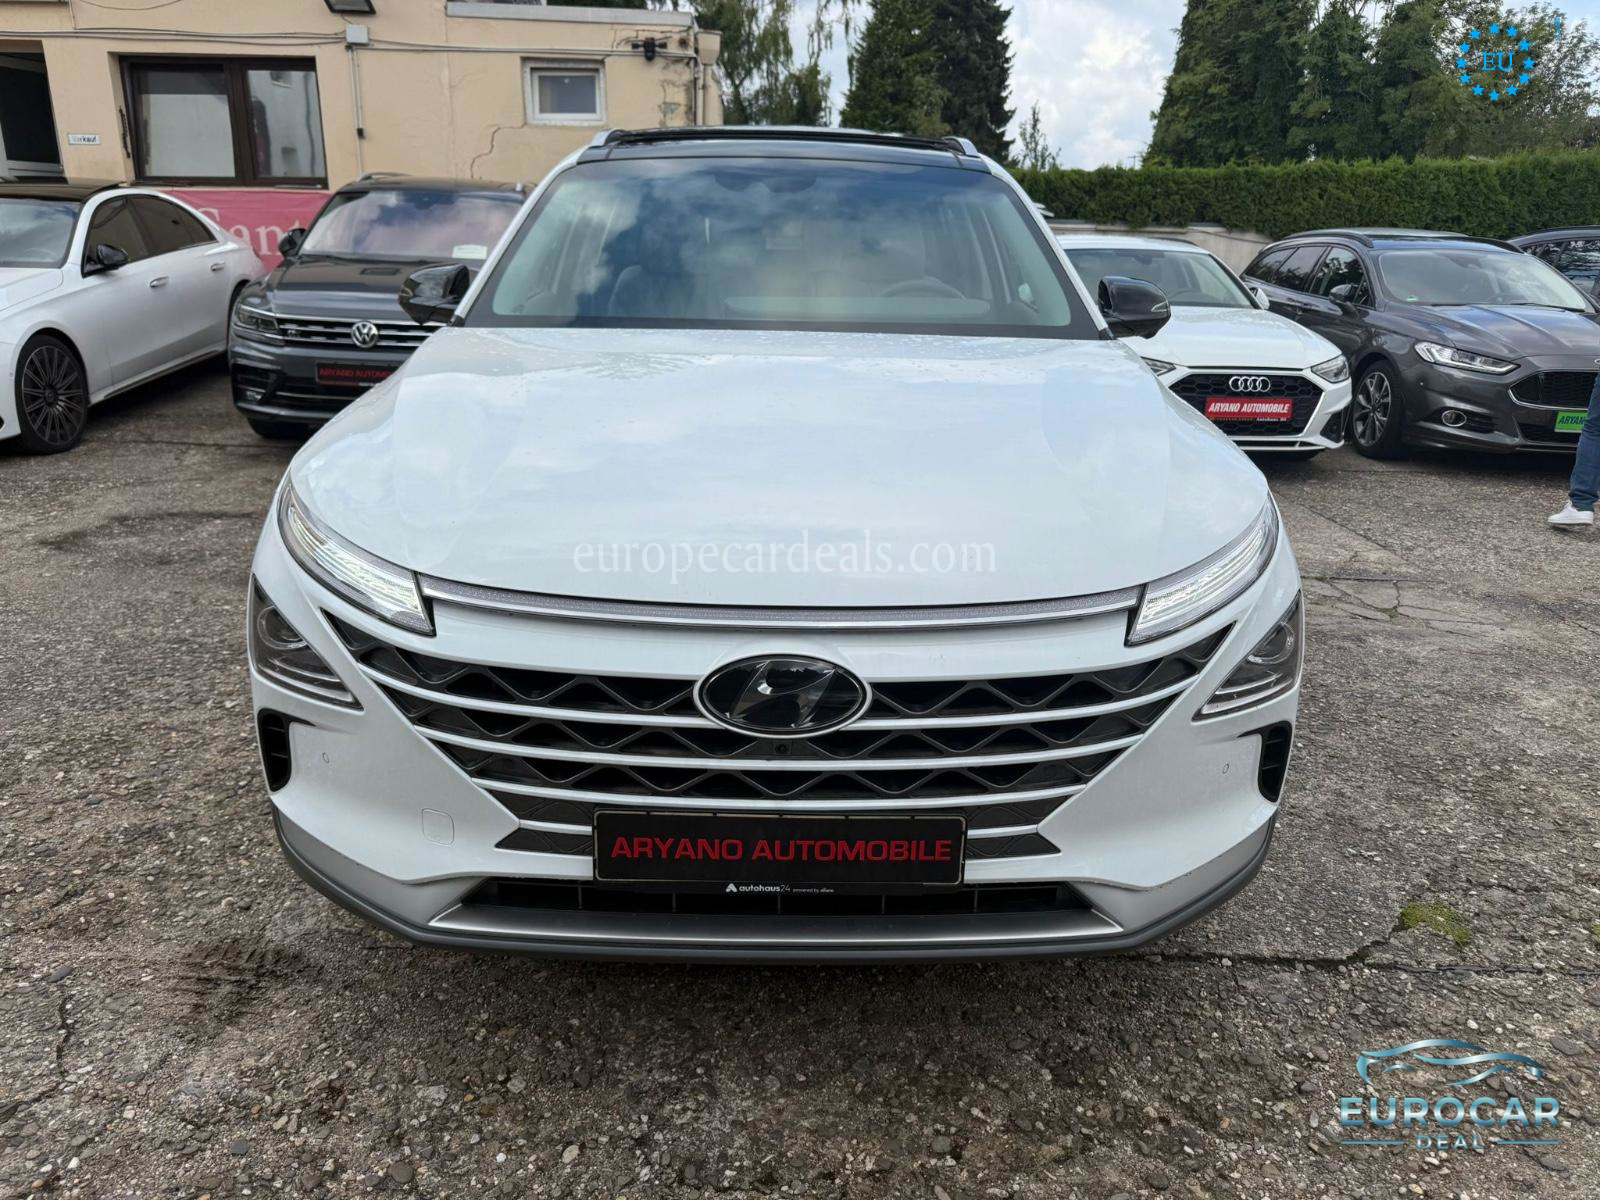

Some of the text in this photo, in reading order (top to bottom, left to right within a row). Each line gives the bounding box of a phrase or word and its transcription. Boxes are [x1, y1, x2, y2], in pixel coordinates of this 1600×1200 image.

[1208, 402, 1289, 413] ARYANO AUTOMOBILE
[610, 836, 952, 862] ARYANO AUTOMOBILE
[738, 884, 791, 892] autohaus24
